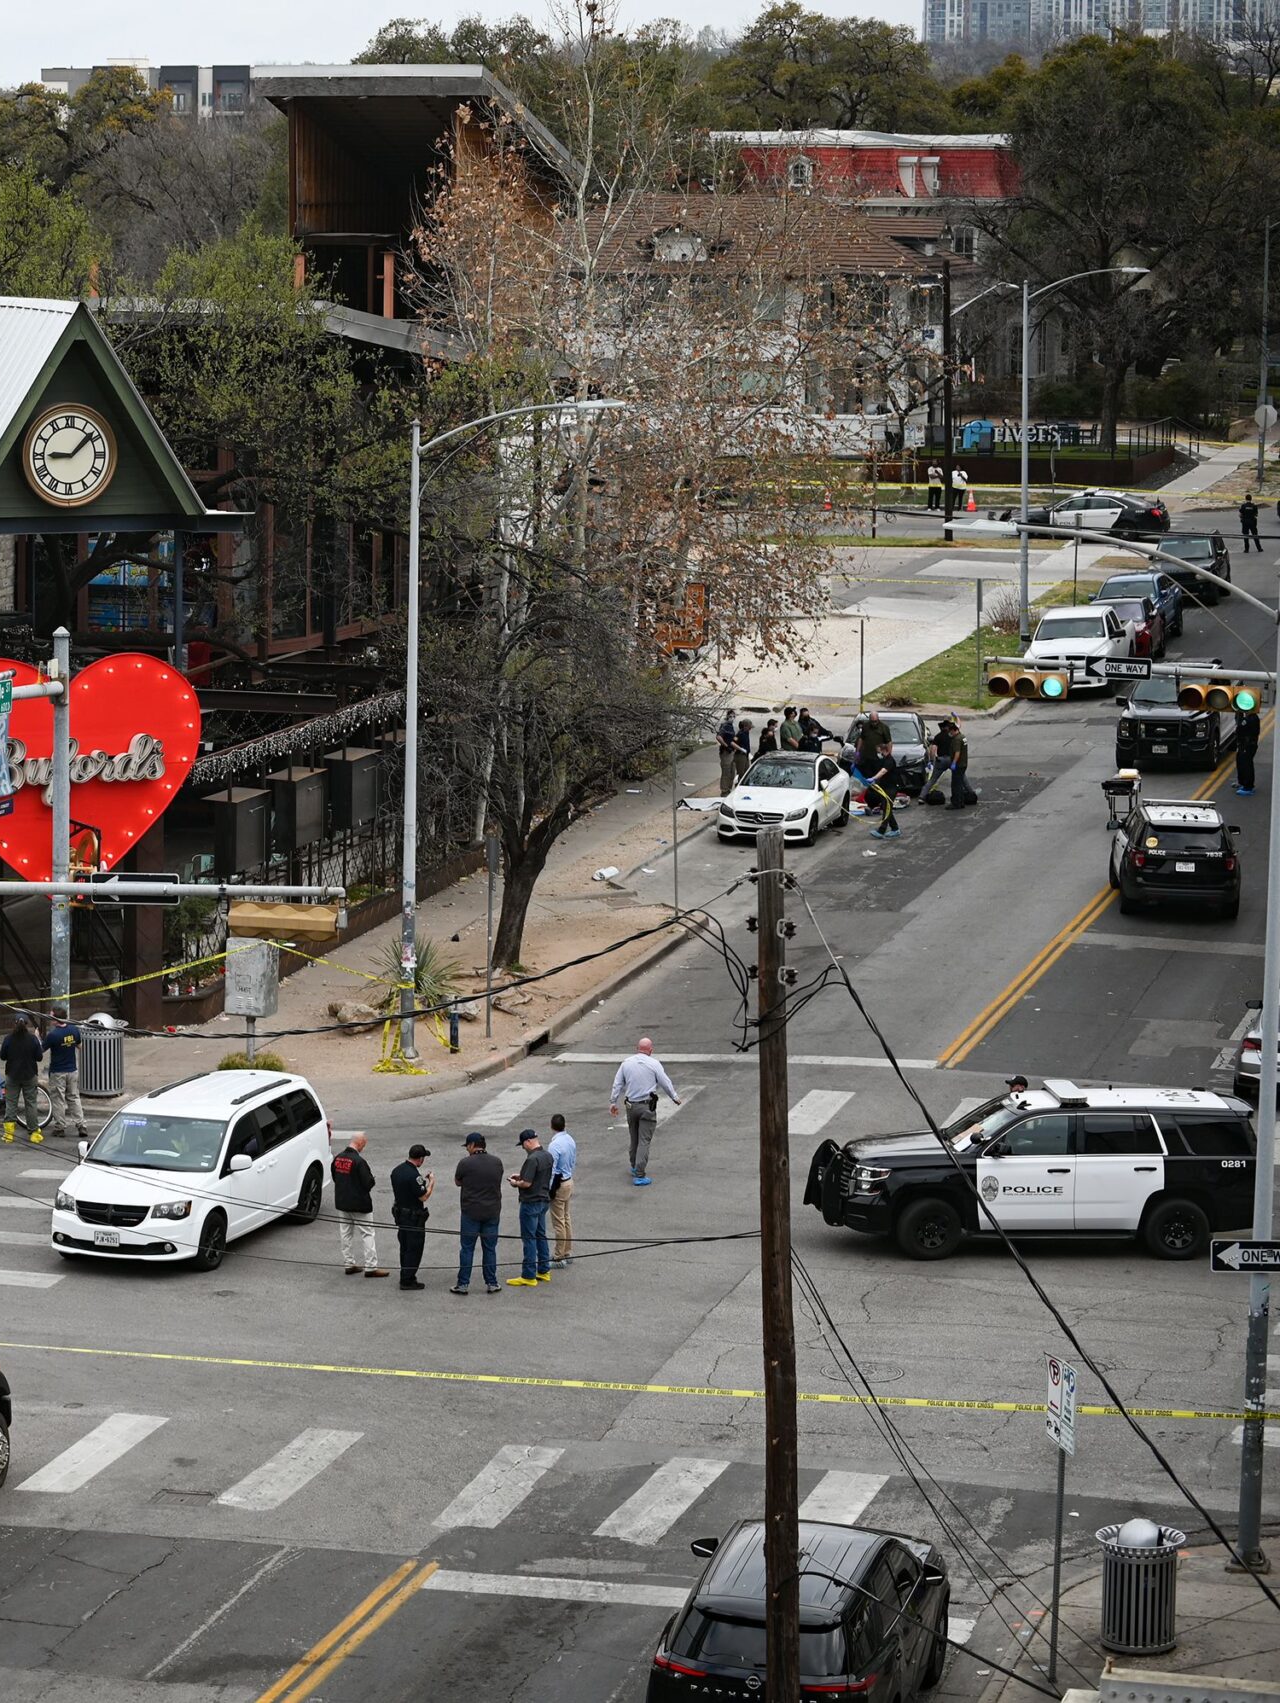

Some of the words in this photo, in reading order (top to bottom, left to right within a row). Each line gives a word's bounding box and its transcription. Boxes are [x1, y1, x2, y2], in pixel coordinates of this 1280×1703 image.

[1105, 663, 1122, 673] ONE
[1125, 664, 1144, 674] WAY
[1221, 1160, 1246, 1168] 0281
[1242, 1250, 1268, 1262] ONE
